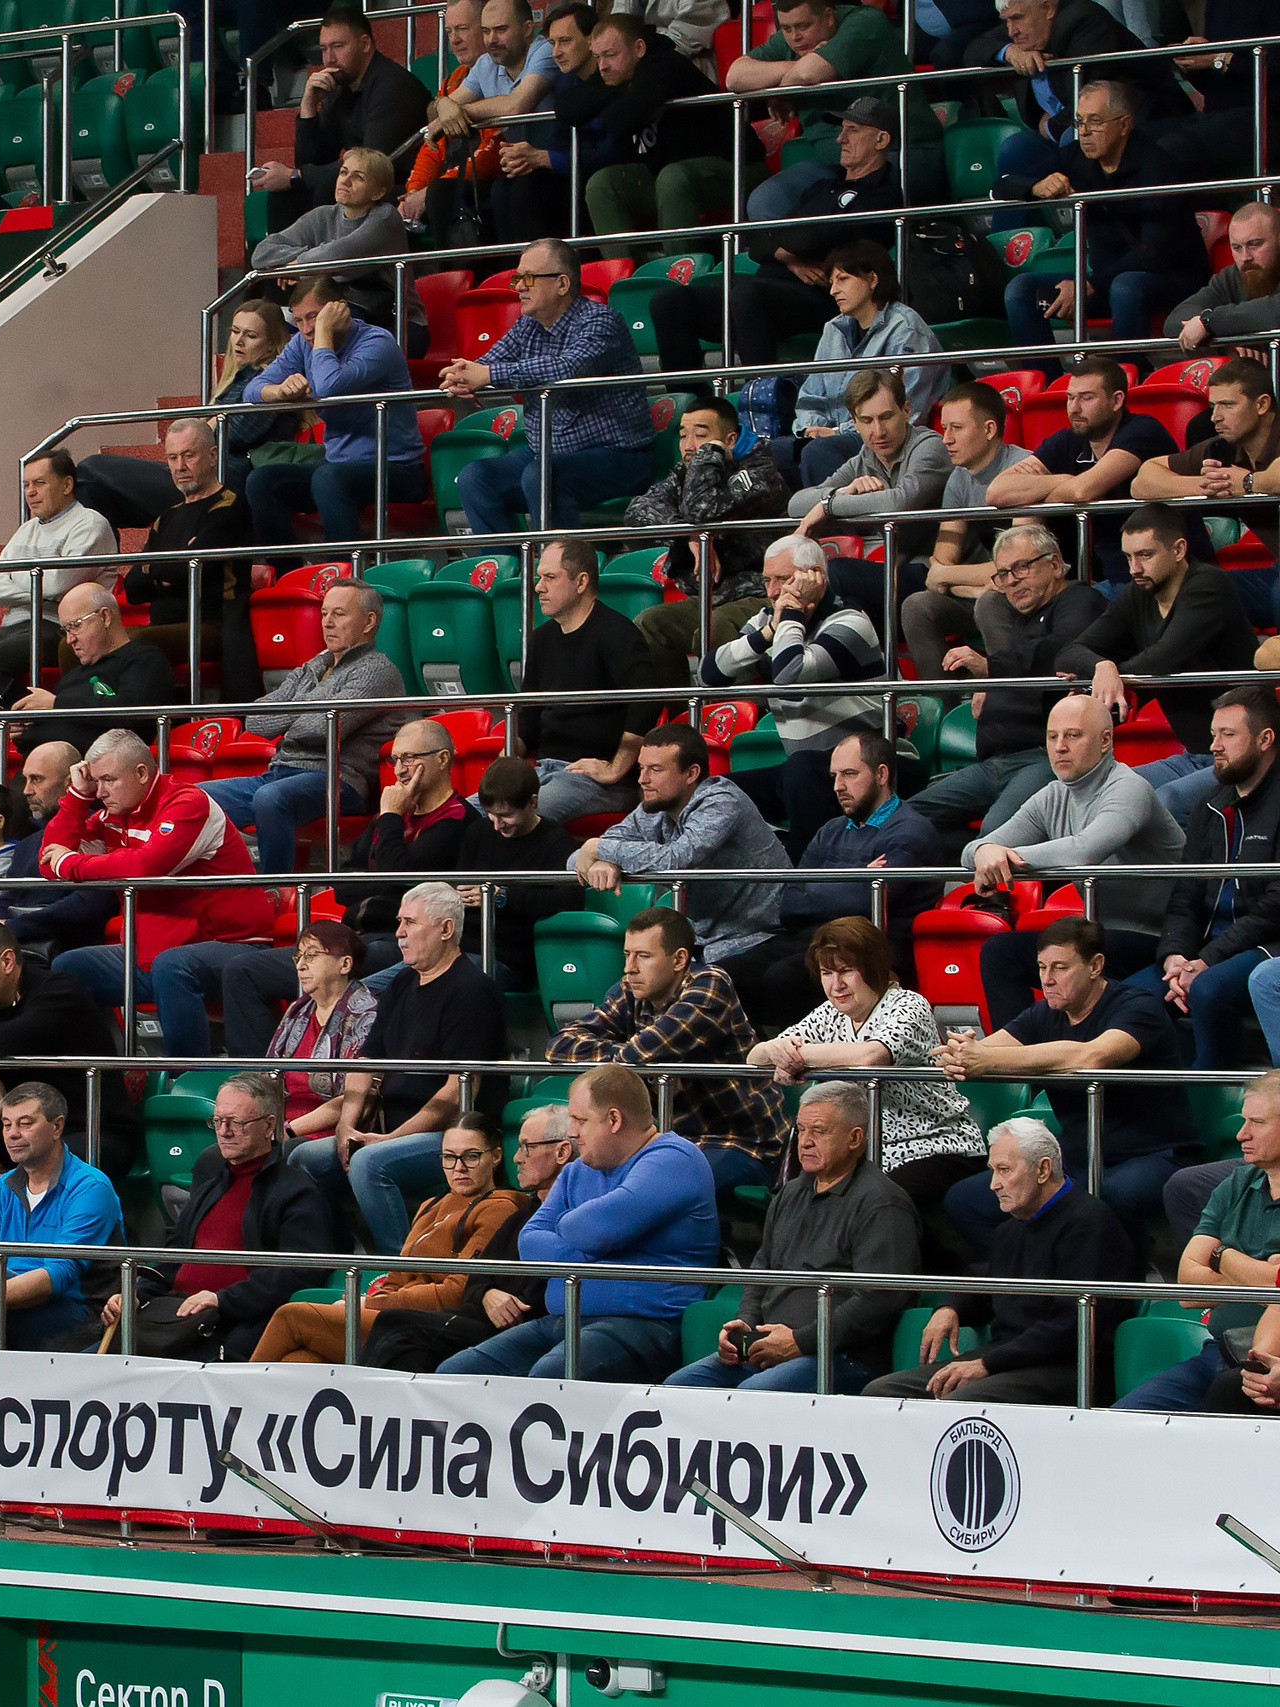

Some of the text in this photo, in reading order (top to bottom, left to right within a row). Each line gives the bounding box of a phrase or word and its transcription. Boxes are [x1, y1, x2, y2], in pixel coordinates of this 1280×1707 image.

[949, 1422, 1003, 1451] БИЛЬЯРД
[256, 1388, 493, 1498] «Сила
[509, 1402, 868, 1546] Сибири»
[949, 1526, 997, 1545] СИБИРИ
